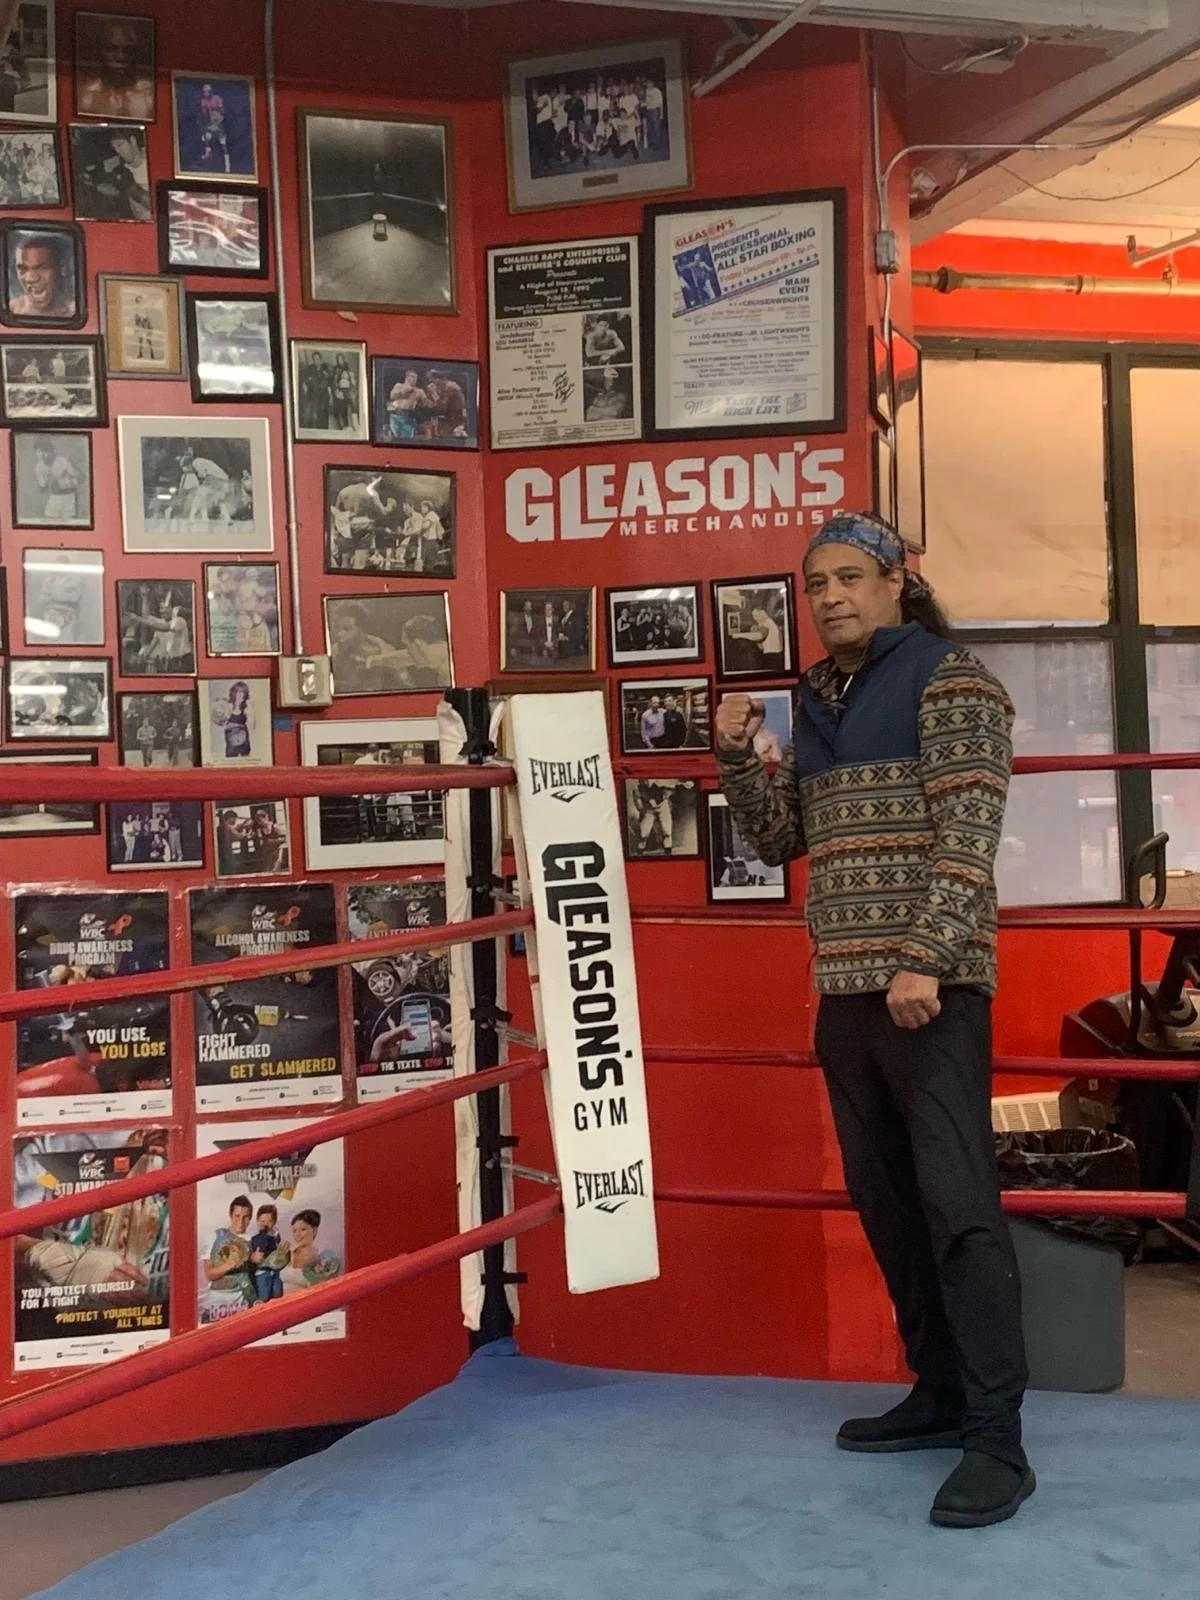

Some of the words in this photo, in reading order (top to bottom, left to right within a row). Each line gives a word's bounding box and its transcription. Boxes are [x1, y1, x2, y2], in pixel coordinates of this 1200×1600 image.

[711, 228, 760, 253] PRESENTS
[713, 227, 790, 261] PROFESSIONAL
[503, 254, 539, 265] CHARLES
[566, 245, 621, 258] ENTERPRISES
[717, 259, 738, 272] ALL
[740, 249, 769, 264] STAR
[771, 227, 816, 252] BOXING
[563, 255, 604, 267] COUNTRY
[605, 253, 627, 262] CLUB
[785, 276, 810, 286] MAIN
[779, 285, 810, 295] EVENT
[497, 321, 538, 330] FEATURING
[505, 441, 845, 543] GLEASON'S
[529, 754, 602, 795] EVERLAST
[252, 919, 276, 930] WBC
[408, 914, 430, 926] WBC
[80, 928, 105, 940] WBC
[215, 932, 256, 947] ALCOHOL
[257, 929, 310, 944] AWARENESS
[50, 942, 75, 955] DRUG
[77, 940, 133, 952] AWARENESS
[240, 943, 284, 957] PROGRAM
[68, 952, 115, 965] PROGRAM
[541, 840, 632, 1090] GLEASON'S
[87, 1029, 117, 1044] YOU
[120, 1027, 151, 1042] USE,
[198, 1033, 238, 1049] FIGHT
[100, 1044, 129, 1060] YOU
[134, 1041, 166, 1058] LOSE
[198, 1044, 271, 1063] HAMMERED
[230, 1063, 255, 1080] GET
[260, 1057, 336, 1078] SLAMMERED
[381, 1061, 395, 1072] THE
[574, 1096, 628, 1131] GYM
[80, 1167, 105, 1180] WBC
[573, 1159, 645, 1209] EVERLAST
[22, 1288, 42, 1299] YOU
[44, 1284, 87, 1298] PROTECT
[91, 1280, 135, 1294] YOURSELF
[21, 1299, 40, 1310] FOR
[42, 1298, 51, 1308] A
[52, 1296, 79, 1307] FIGHT
[55, 1311, 99, 1324] PROTECT
[103, 1307, 148, 1320] YOURSELF
[151, 1304, 163, 1315] AT
[117, 1319, 134, 1329] ALL
[136, 1315, 163, 1327] TIMES
